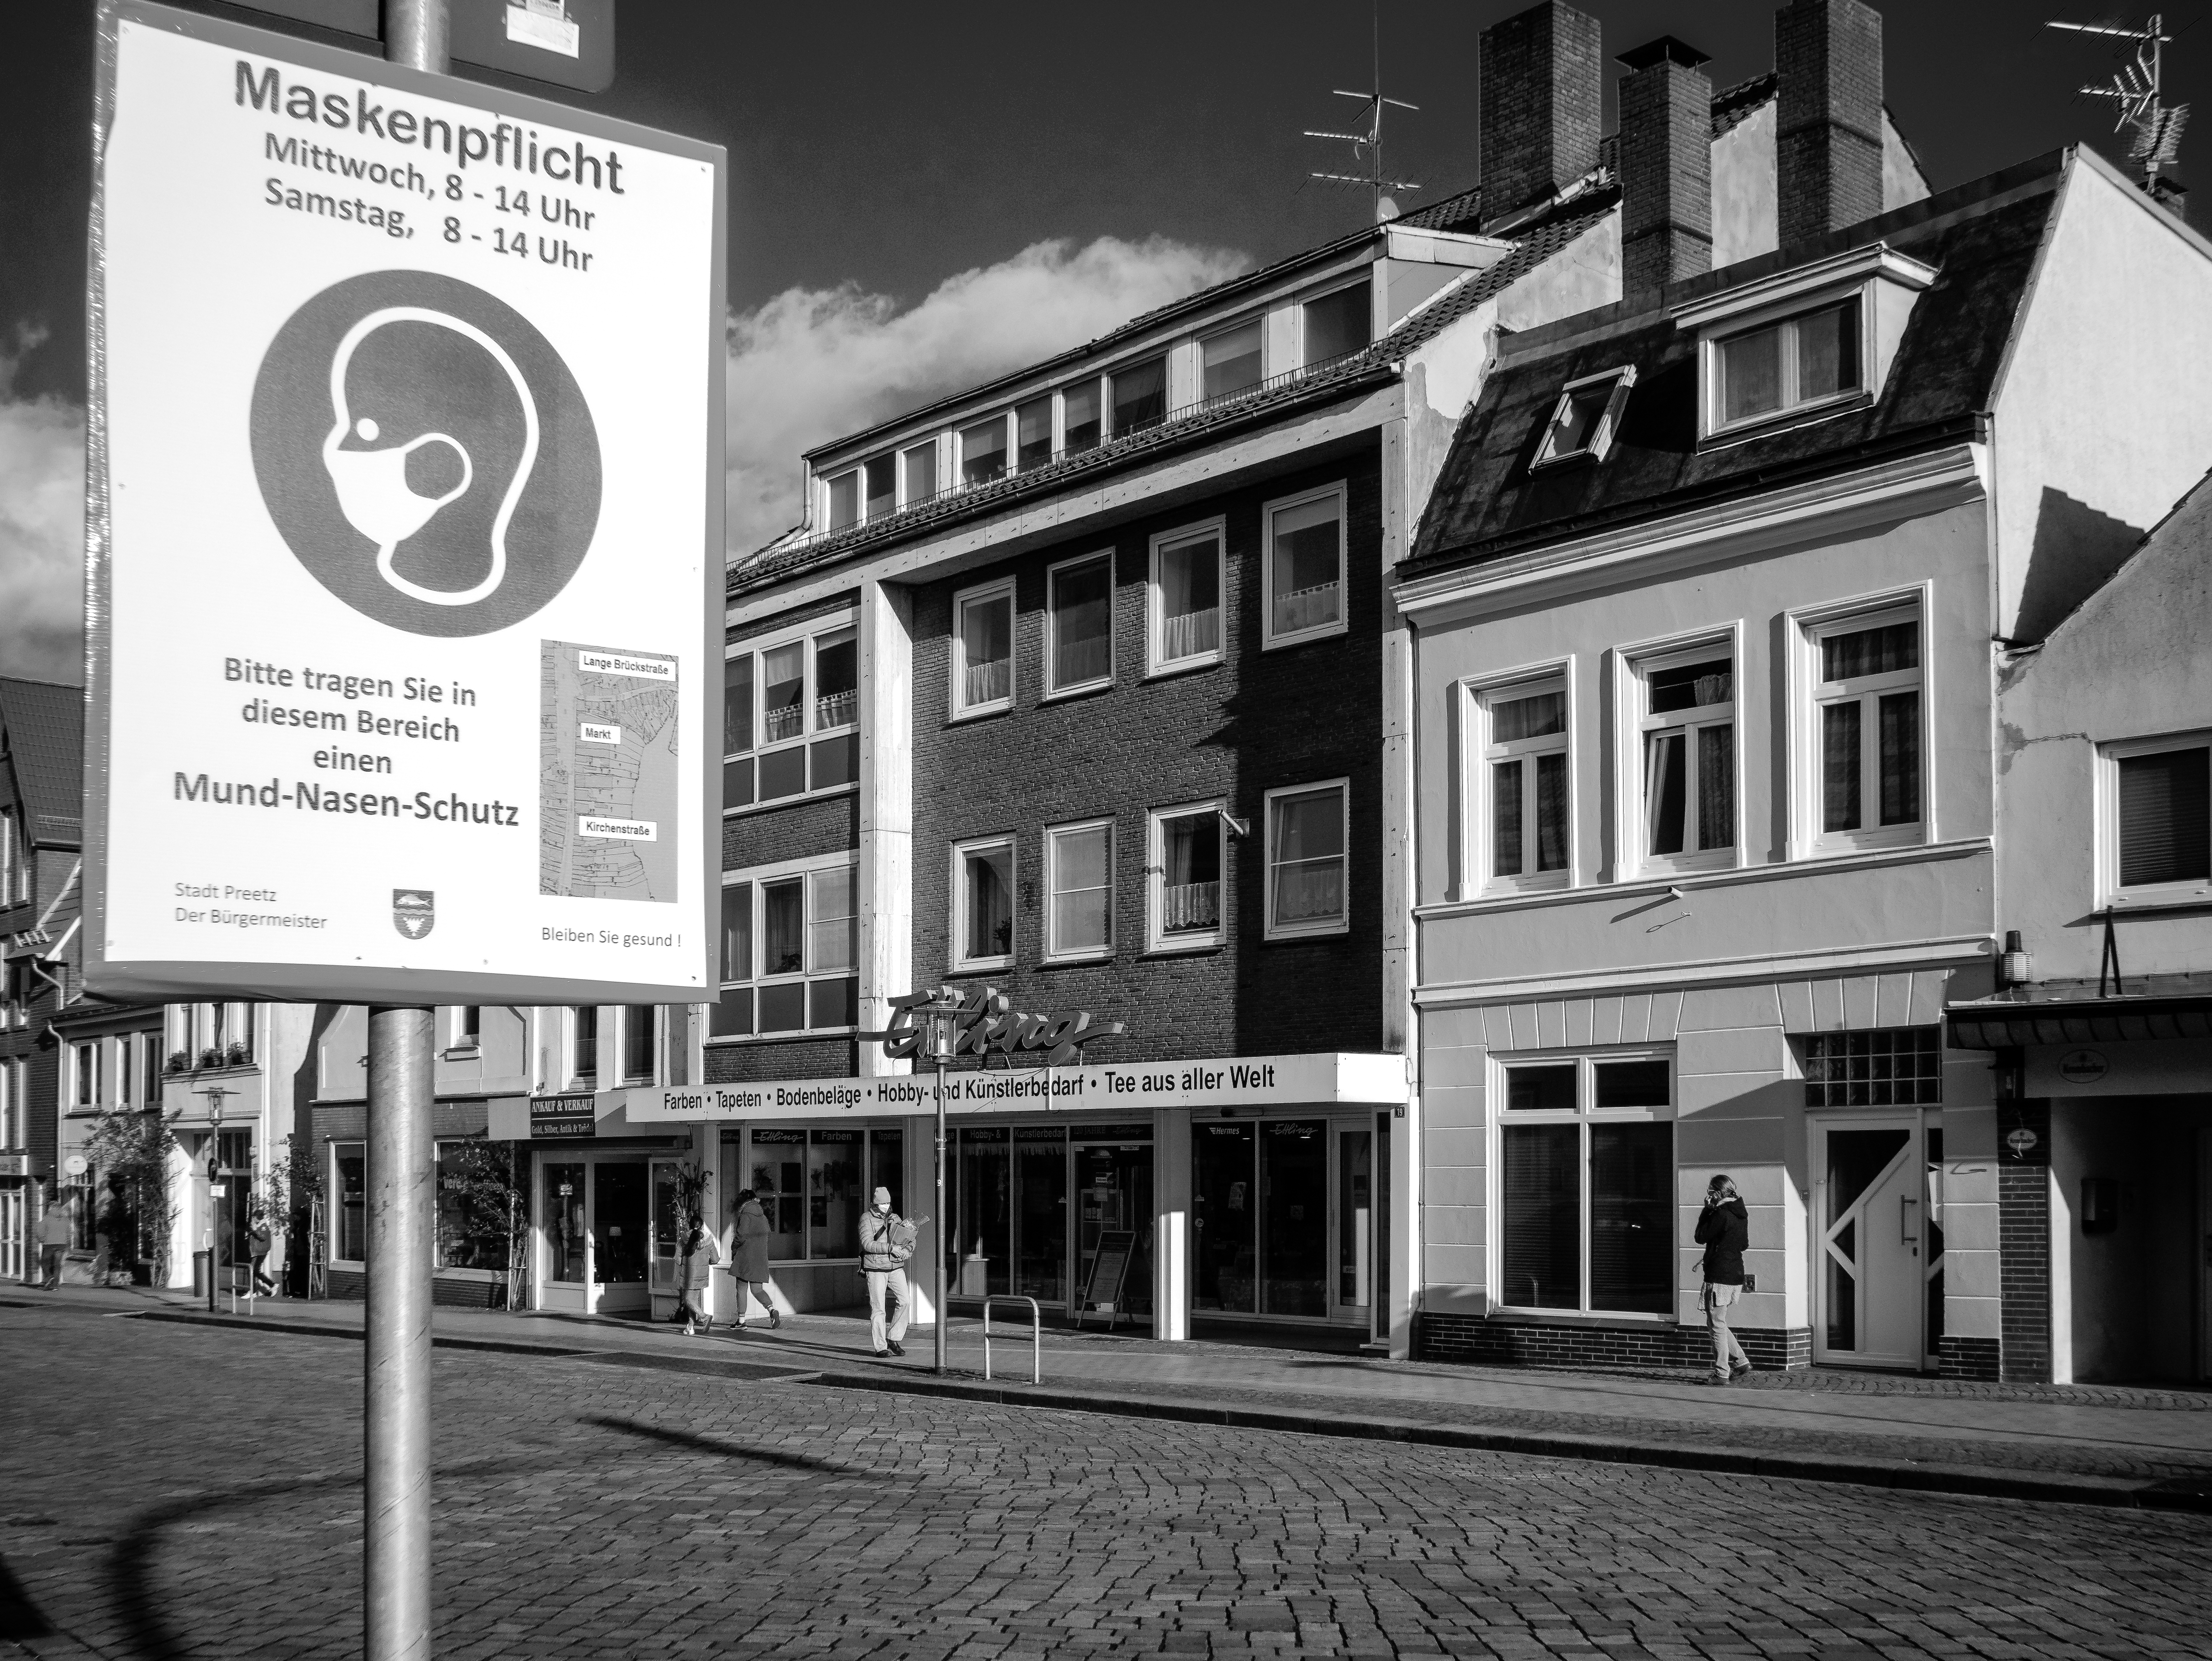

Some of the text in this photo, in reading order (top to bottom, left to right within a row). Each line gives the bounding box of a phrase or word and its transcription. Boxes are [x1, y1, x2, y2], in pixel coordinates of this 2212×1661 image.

[235, 60, 625, 196] Maskenpflicht
[265, 132, 436, 201] Mittwoch,
[445, 174, 462, 201] 8
[496, 186, 530, 216] 14
[541, 195, 595, 230] Uhr
[265, 177, 414, 238] Samstag,
[444, 217, 461, 243] 8
[494, 228, 528, 258] 14
[539, 237, 593, 271] Uhr
[584, 656, 668, 674] Lange Brückstraße
[225, 658, 475, 706] Bitte tragen Sie in
[243, 698, 459, 742] diesem Bereich
[586, 728, 610, 739] Markt
[314, 745, 391, 774] einen
[175, 772, 518, 826] Mund-Nasen-Schutz
[587, 822, 649, 835] Kirchenstraße
[175, 883, 276, 901] Stadt Preetz
[176, 908, 328, 928] Der Bürgermeister
[543, 928, 594, 942] Bleiben
[600, 931, 619, 943] Sie
[623, 934, 672, 947] gesund
[856, 985, 1124, 1066] Eling
[665, 1093, 702, 1109] Farben
[716, 1091, 761, 1112] Tapeten
[777, 1085, 861, 1109] Bodenbeläge
[879, 1082, 928, 1106] Hobby-
[965, 1075, 1083, 1099] Künstlerbedarf
[1105, 1071, 1135, 1093] Tee
[1142, 1075, 1175, 1092] aus
[1182, 1068, 1224, 1090] aller
[1230, 1064, 1274, 1088] Welt
[531, 1098, 593, 1112] ANKAUF & VERKAUF
[1396, 1108, 1403, 1116] 19
[822, 1132, 852, 1141] Farben
[877, 1132, 901, 1142] Tapeten
[970, 1130, 994, 1141] Hobby-
[996, 1129, 1001, 1138] &
[1084, 1126, 1106, 1135] JAHRE
[1216, 1127, 1240, 1135] Hermes
